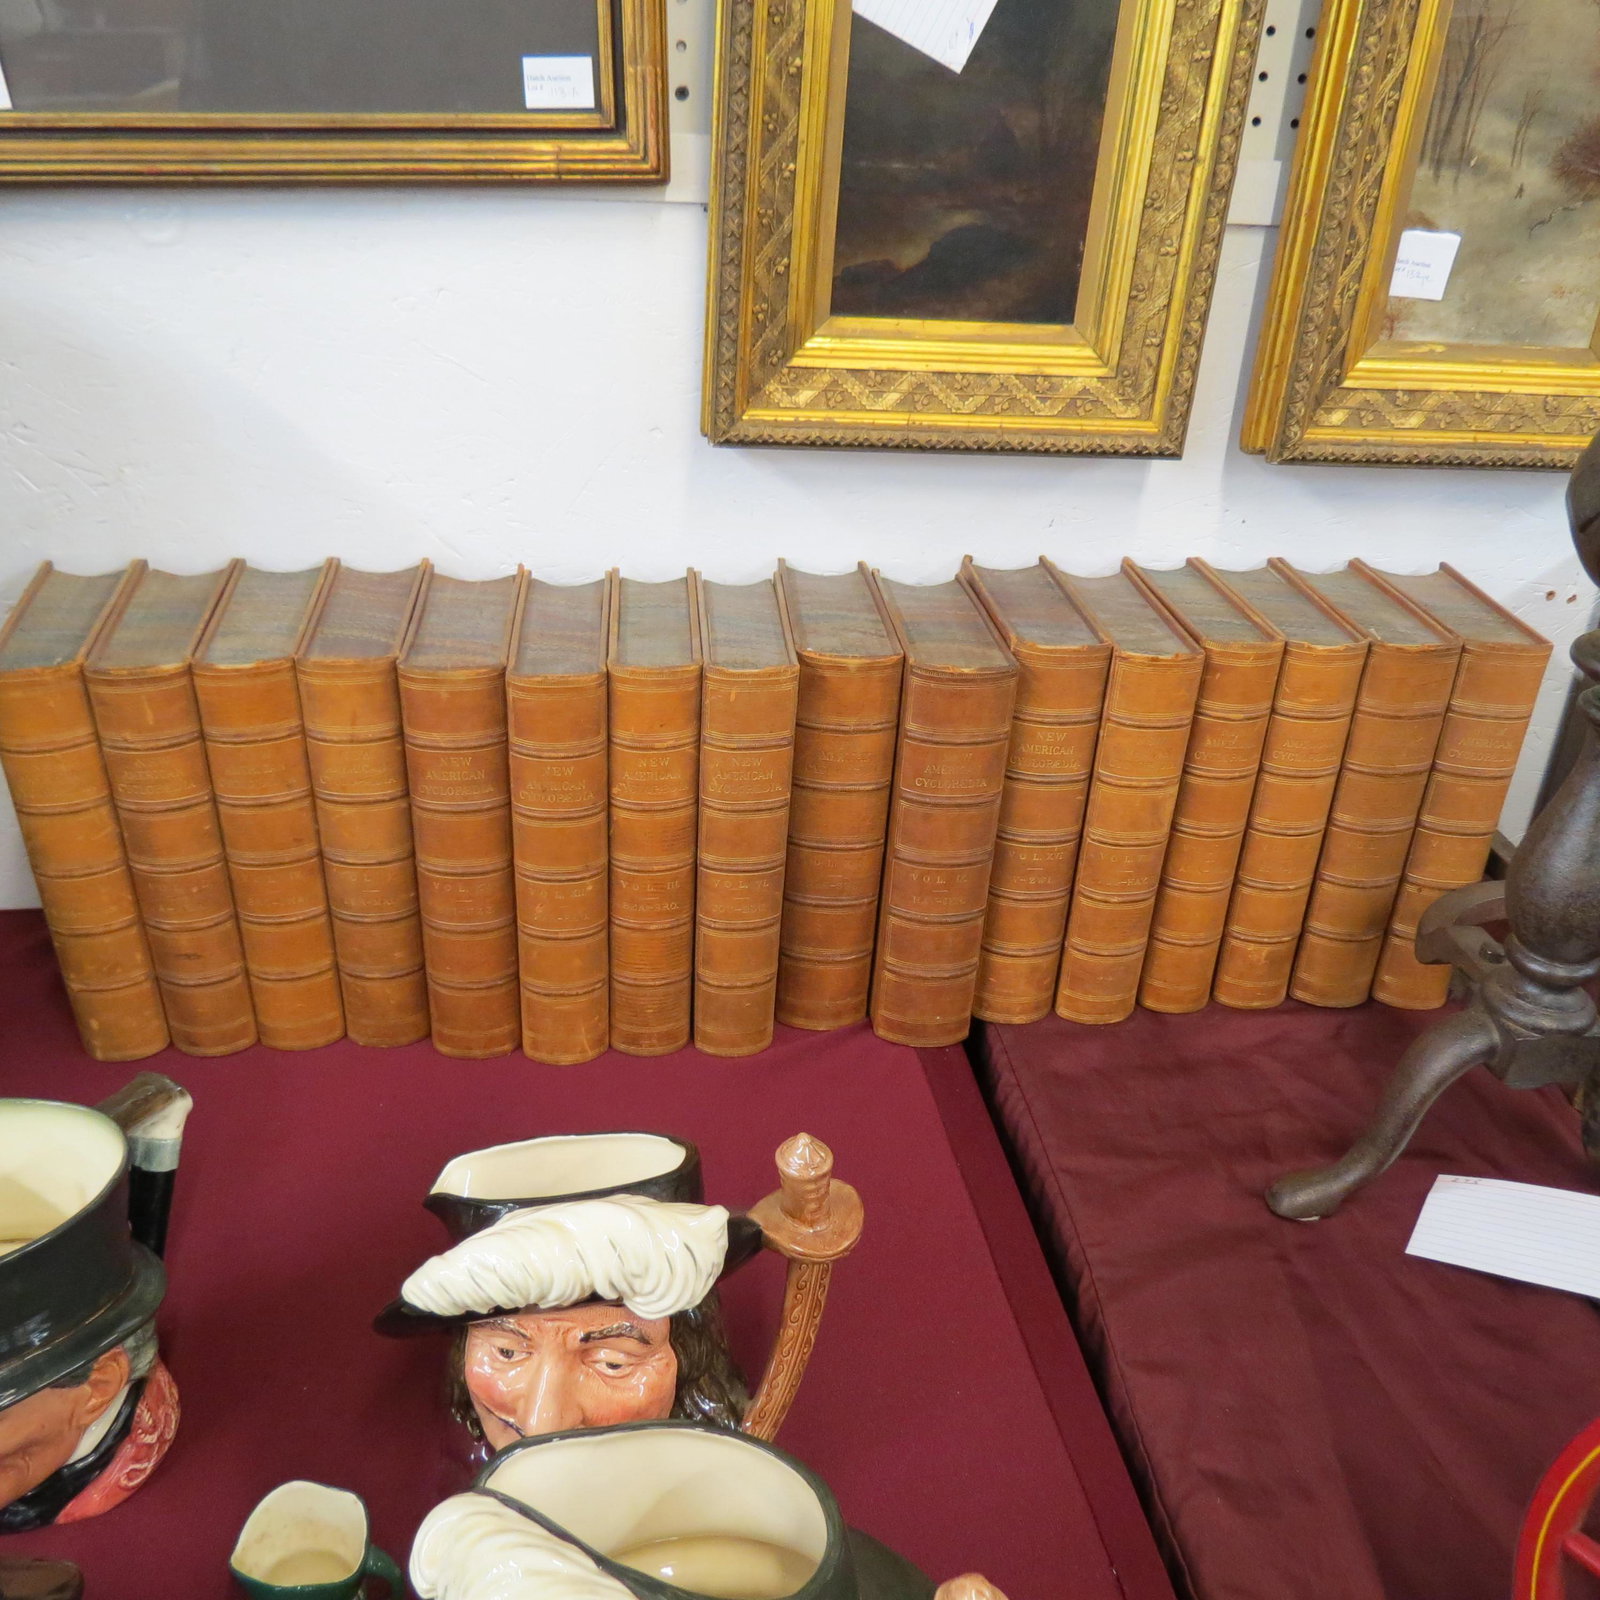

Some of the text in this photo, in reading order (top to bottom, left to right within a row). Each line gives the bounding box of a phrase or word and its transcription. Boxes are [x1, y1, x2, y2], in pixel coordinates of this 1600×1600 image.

[1037, 731, 1068, 742] NEW
[1018, 743, 1075, 755] AMERICAN
[440, 756, 472, 767] NEW
[638, 757, 671, 768] NEW
[731, 757, 762, 767] NEW
[424, 768, 486, 781] AMERICAN
[542, 766, 575, 777] NEW
